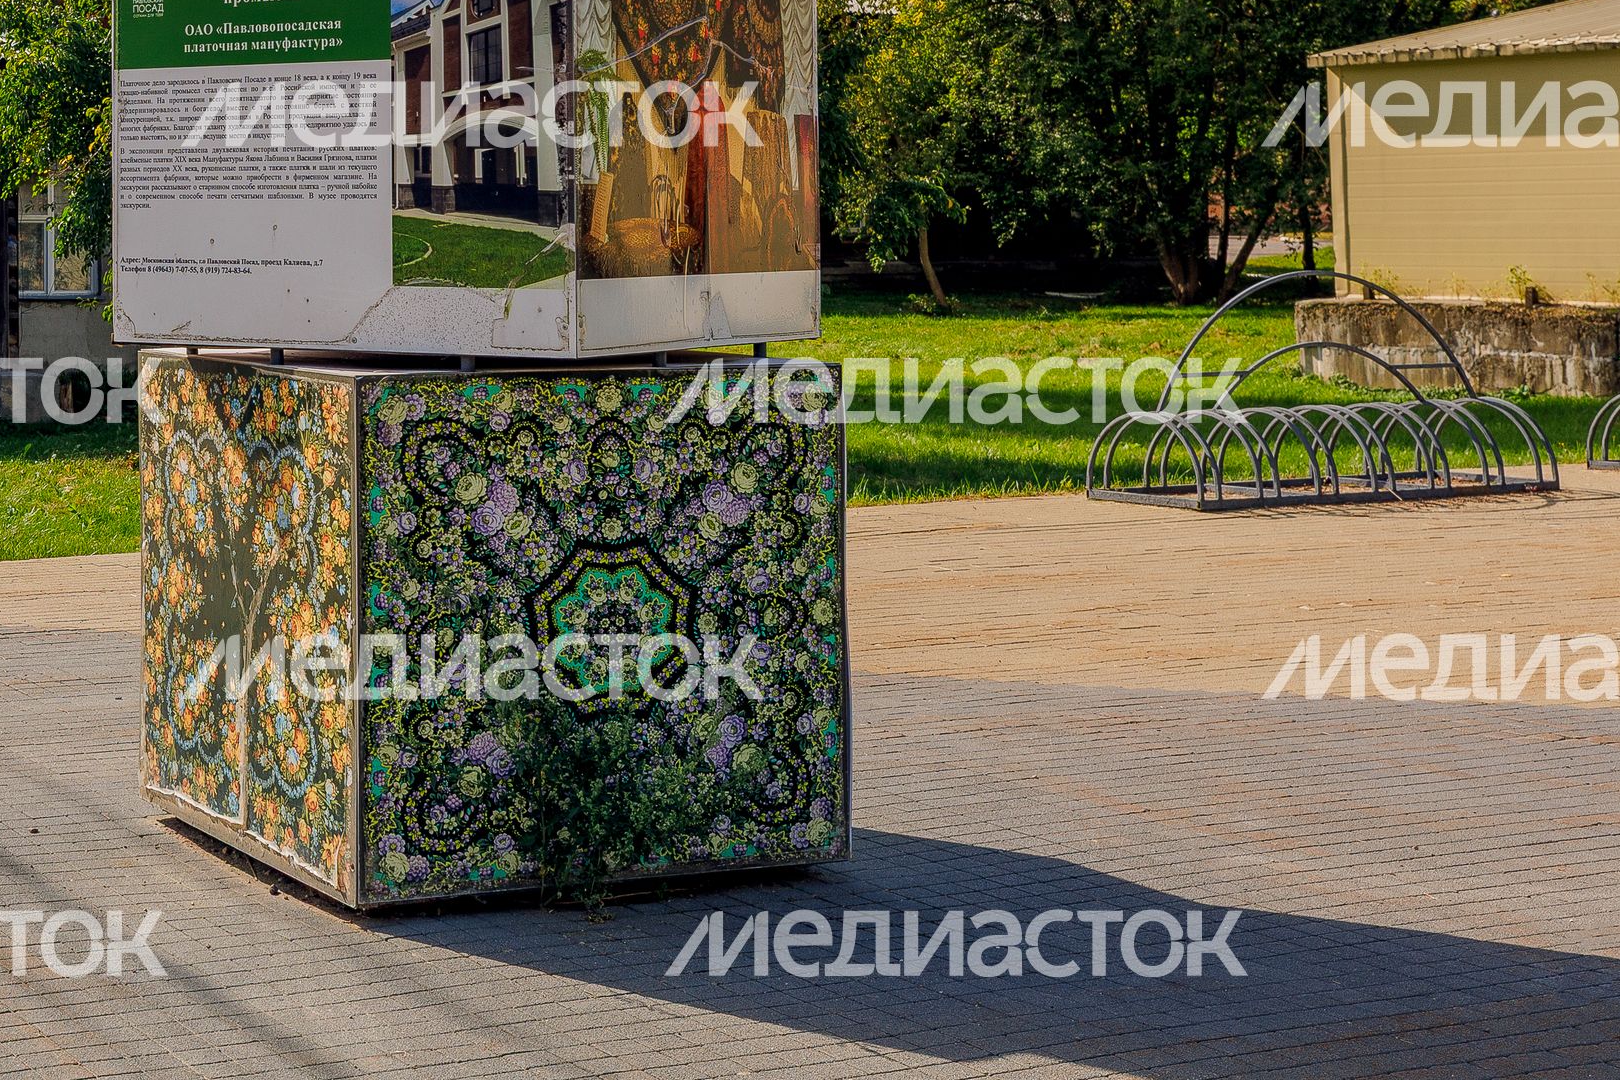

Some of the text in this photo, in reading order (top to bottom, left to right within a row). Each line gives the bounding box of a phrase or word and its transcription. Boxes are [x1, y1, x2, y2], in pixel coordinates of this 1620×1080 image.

[132, 4, 164, 14] ПОСАД
[184, 20, 342, 37] ОАО «Павловопосадская
[184, 36, 343, 54] платочная мануфактура»
